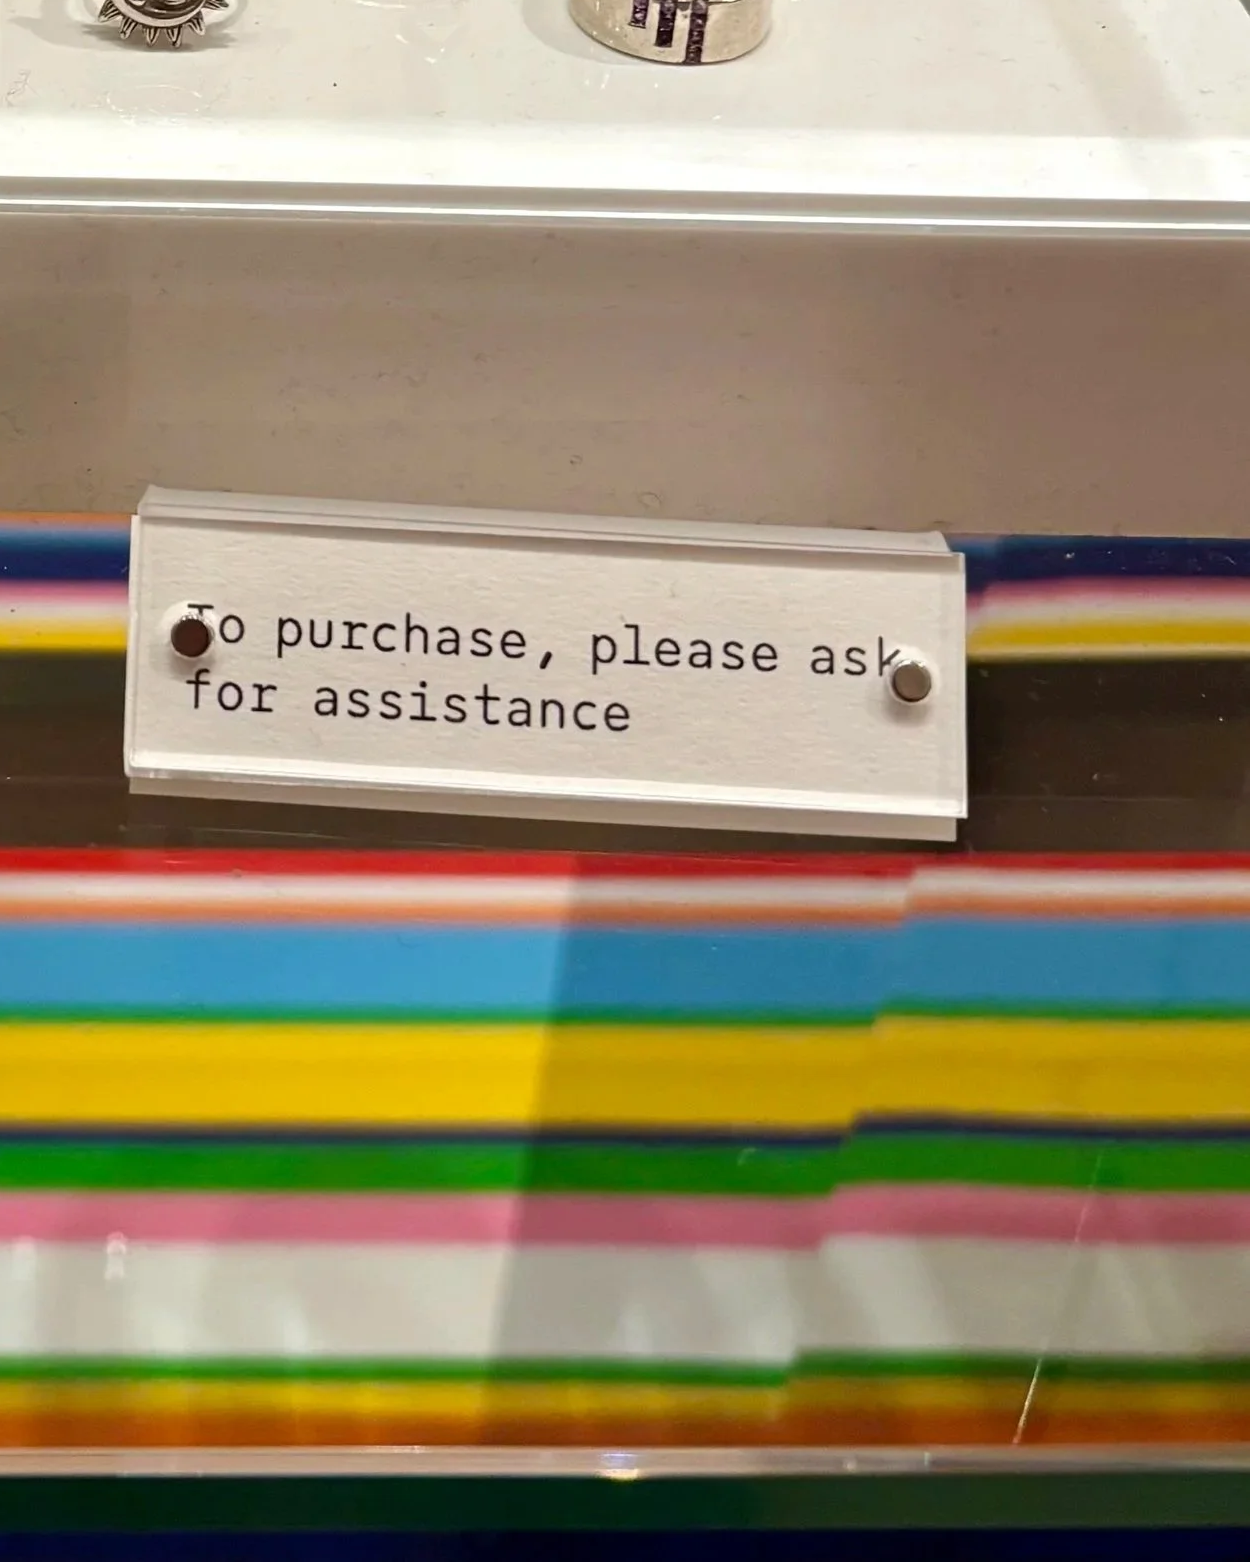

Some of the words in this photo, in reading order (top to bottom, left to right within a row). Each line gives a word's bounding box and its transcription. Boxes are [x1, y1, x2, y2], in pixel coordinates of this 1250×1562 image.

[276, 611, 554, 670] purchase,
[591, 623, 779, 676] please
[810, 635, 902, 677] ask
[185, 668, 279, 714] for
[313, 680, 631, 733] assistance
